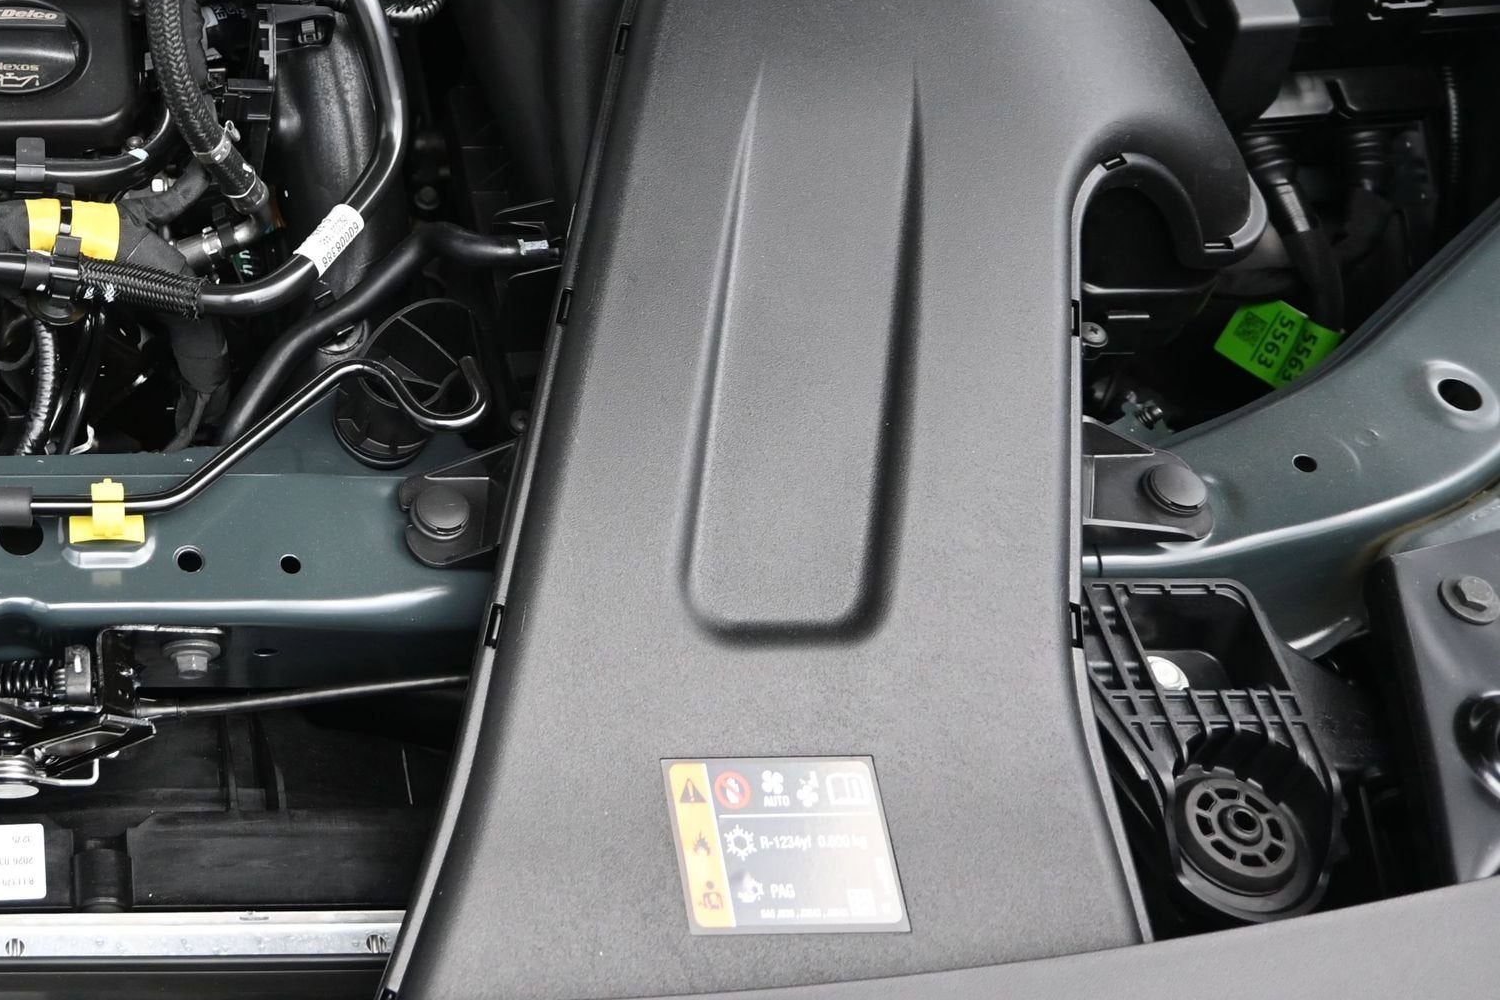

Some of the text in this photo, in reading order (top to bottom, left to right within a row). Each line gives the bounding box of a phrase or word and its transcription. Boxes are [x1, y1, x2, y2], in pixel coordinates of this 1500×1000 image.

[1257, 315, 1296, 369] 5563
[763, 795, 790, 807] AUTO
[770, 883, 796, 899] PAG
